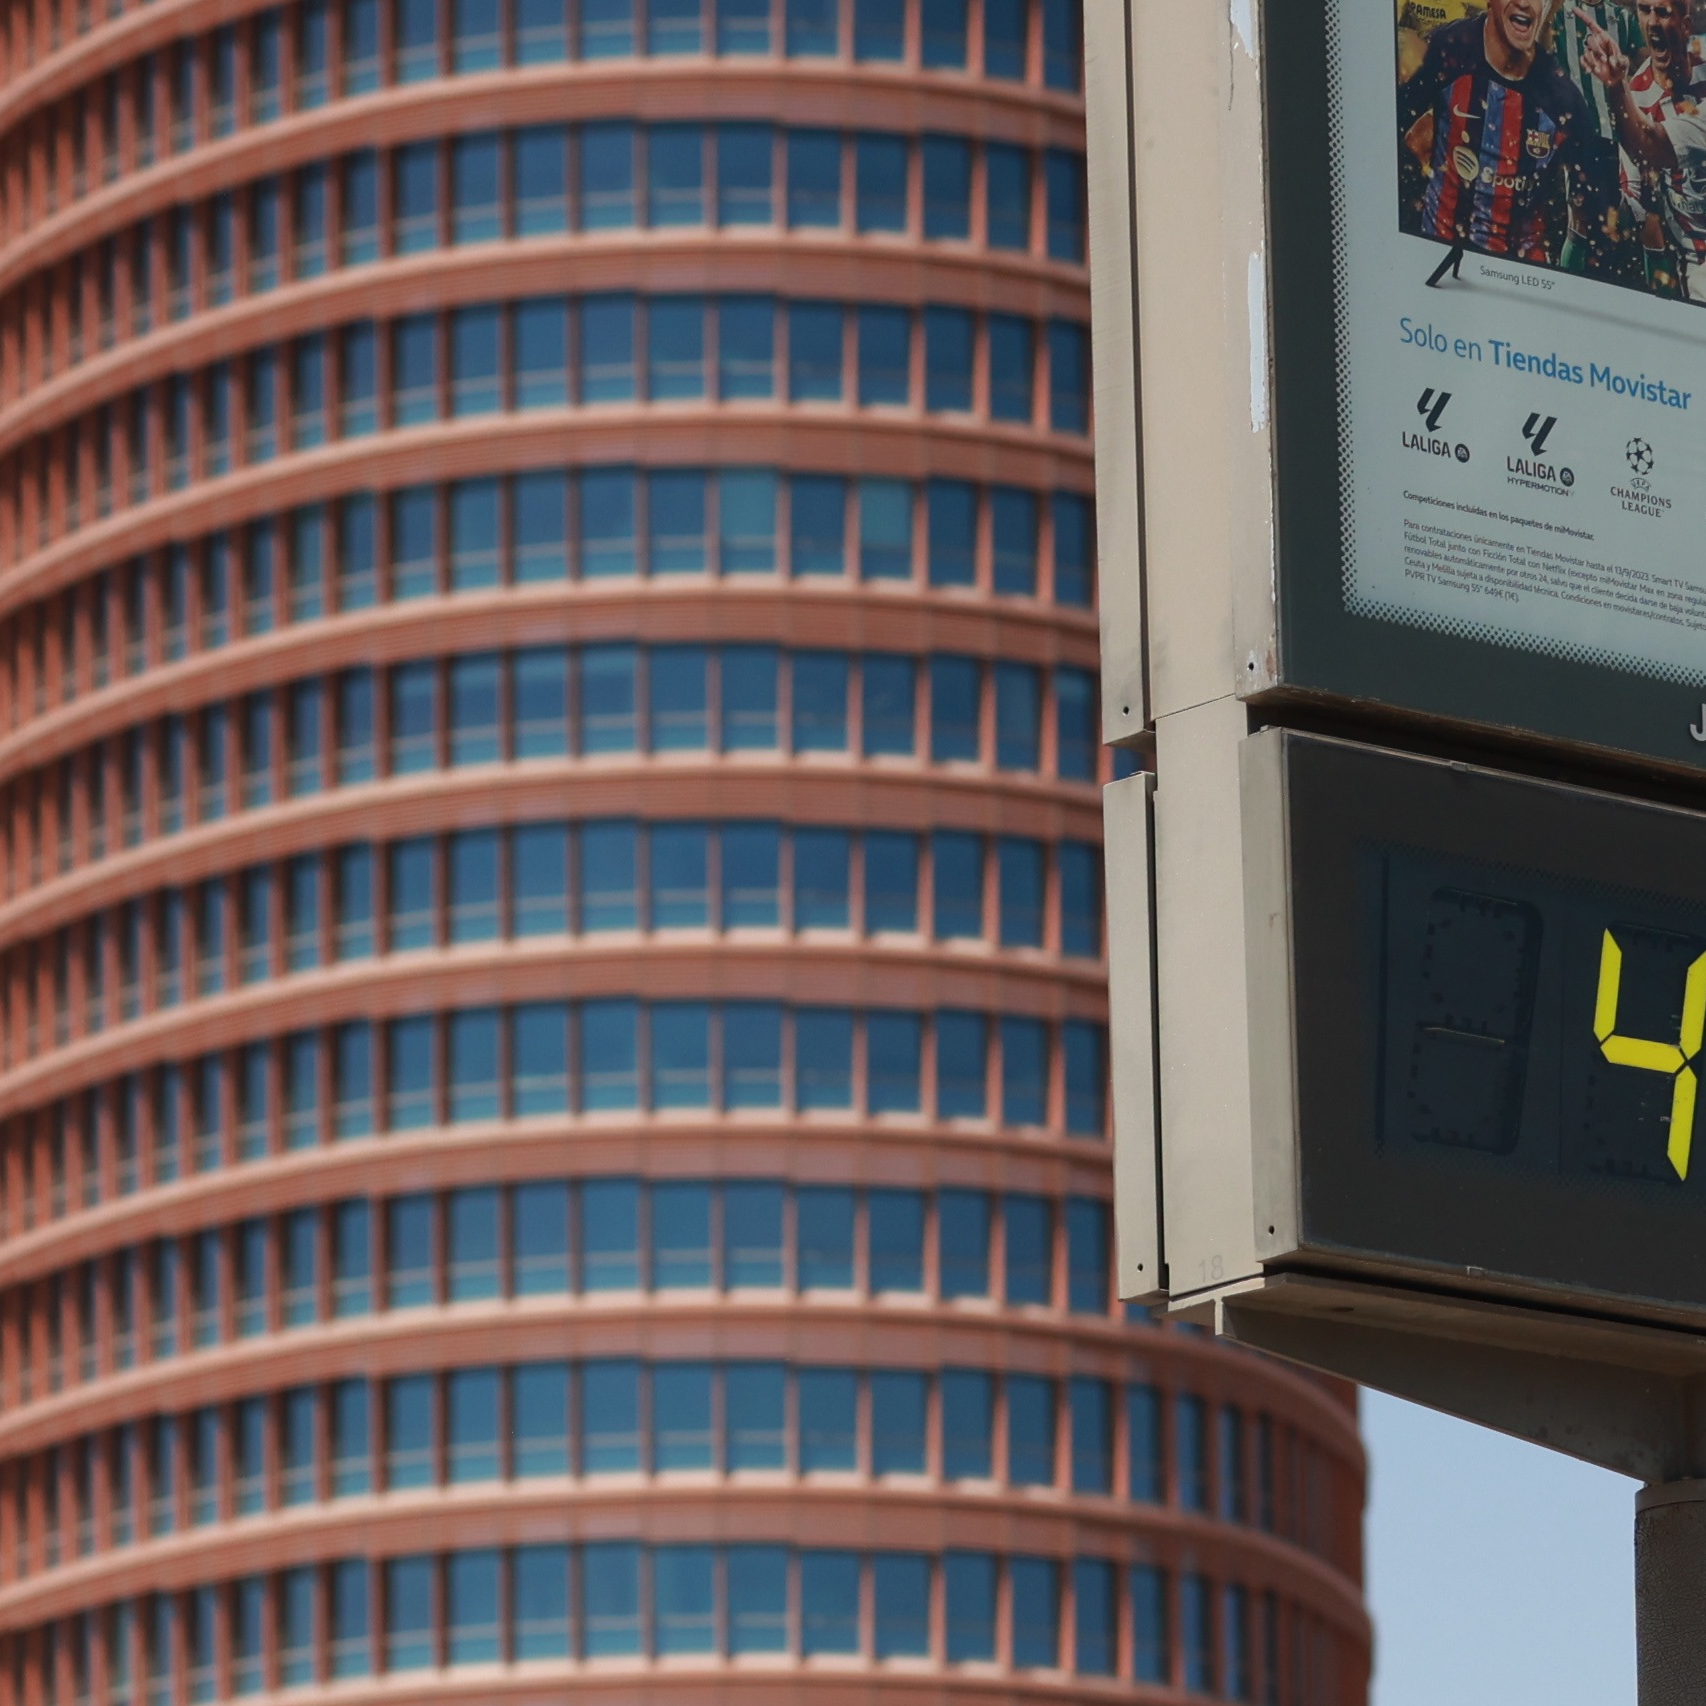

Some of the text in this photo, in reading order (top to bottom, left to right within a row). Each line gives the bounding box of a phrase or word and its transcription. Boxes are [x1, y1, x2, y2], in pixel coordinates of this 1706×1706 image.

[1481, 166, 1533, 192] Spoti
[1480, 265, 1520, 285] Samsung
[1521, 273, 1540, 287] LED
[1400, 317, 1692, 410] Solo en Tiendas Movistar
[1402, 431, 1451, 458] LALIGA
[1507, 456, 1556, 482] LALIGA
[1610, 486, 1672, 508] CHAMPIONS
[1622, 500, 1662, 518] LEAGUE
[1403, 489, 1594, 541] Competiciones incluidas en los paquetes de miMovistar.
[1198, 1254, 1224, 1283] 18
